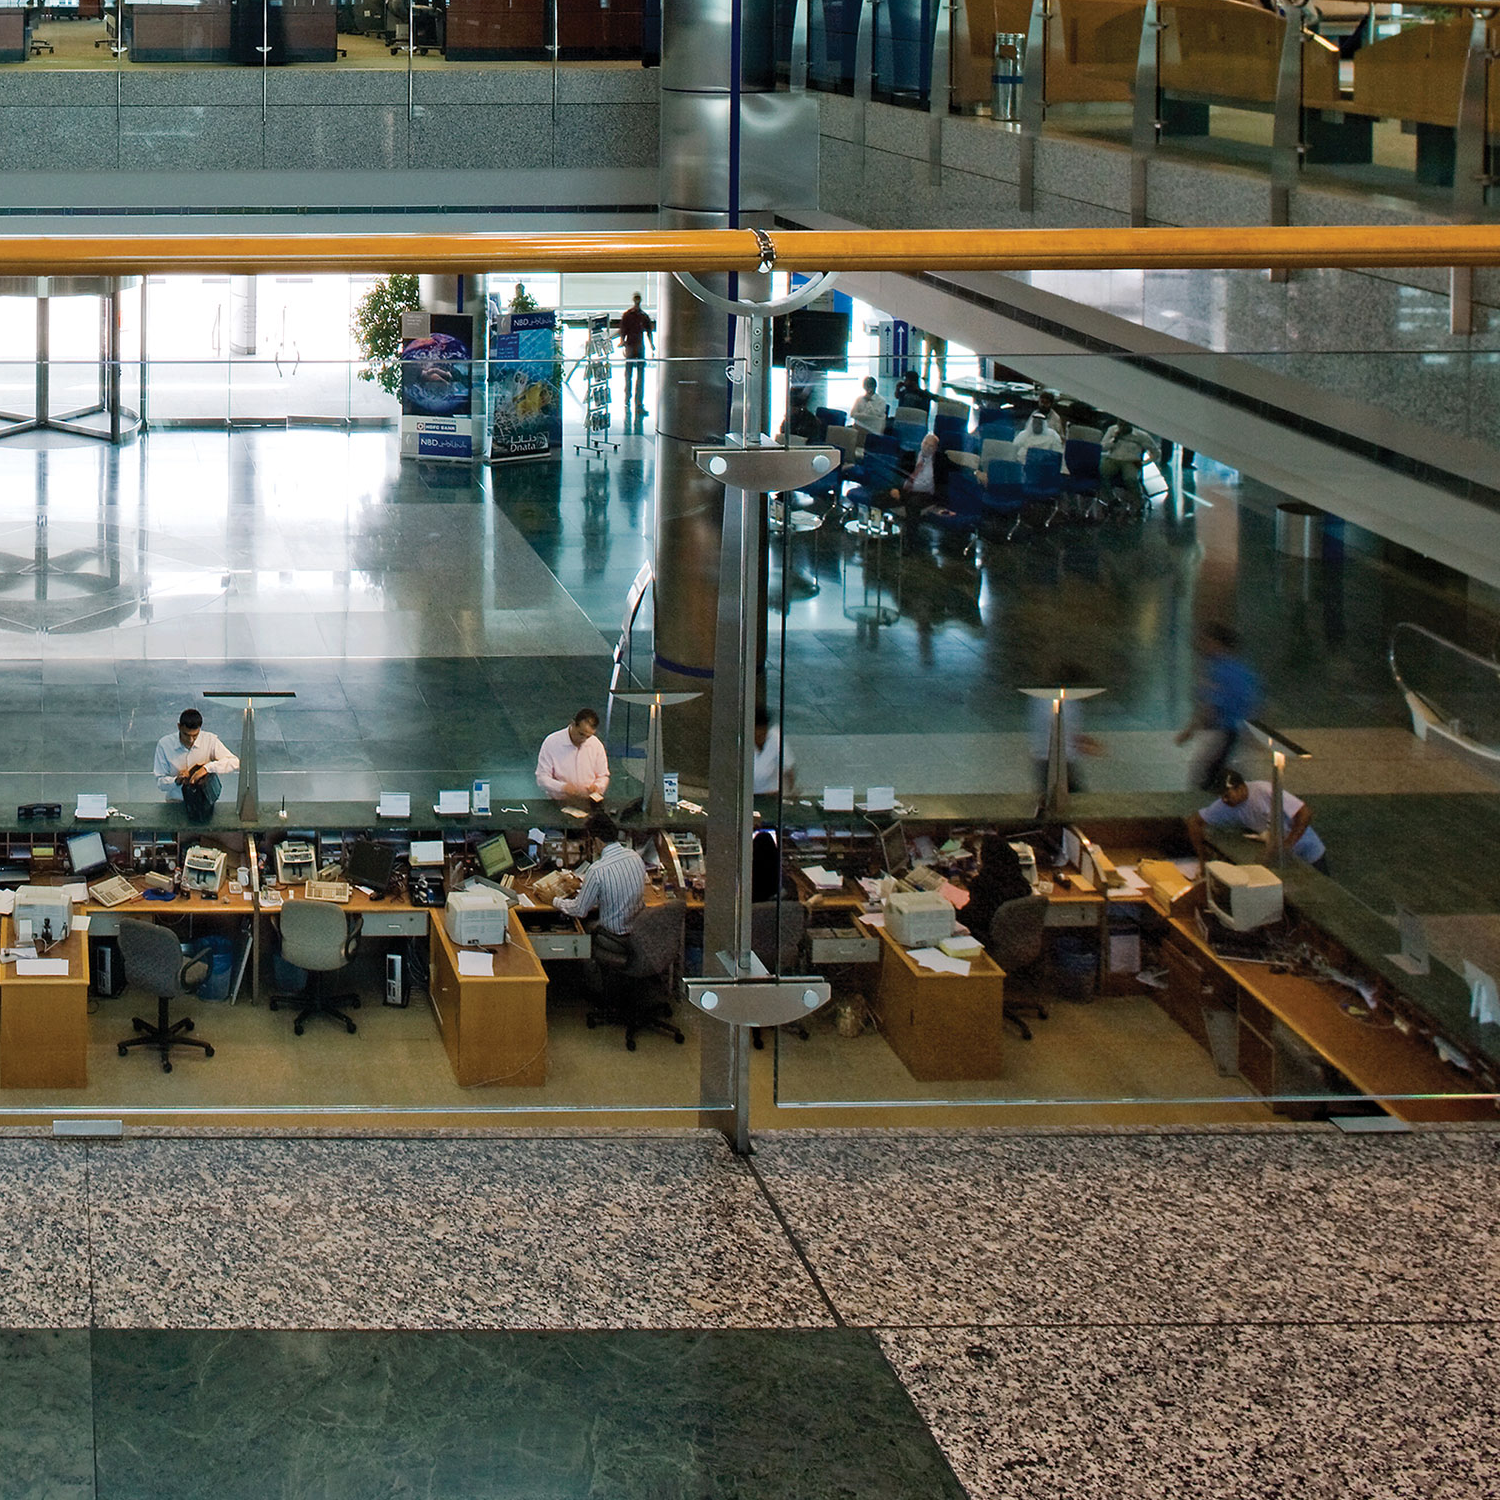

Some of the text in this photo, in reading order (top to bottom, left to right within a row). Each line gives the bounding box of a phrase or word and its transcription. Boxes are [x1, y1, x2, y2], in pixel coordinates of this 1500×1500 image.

[513, 318, 529, 326] NBD
[420, 438, 439, 446] NBD
[510, 443, 536, 452] Dnata
